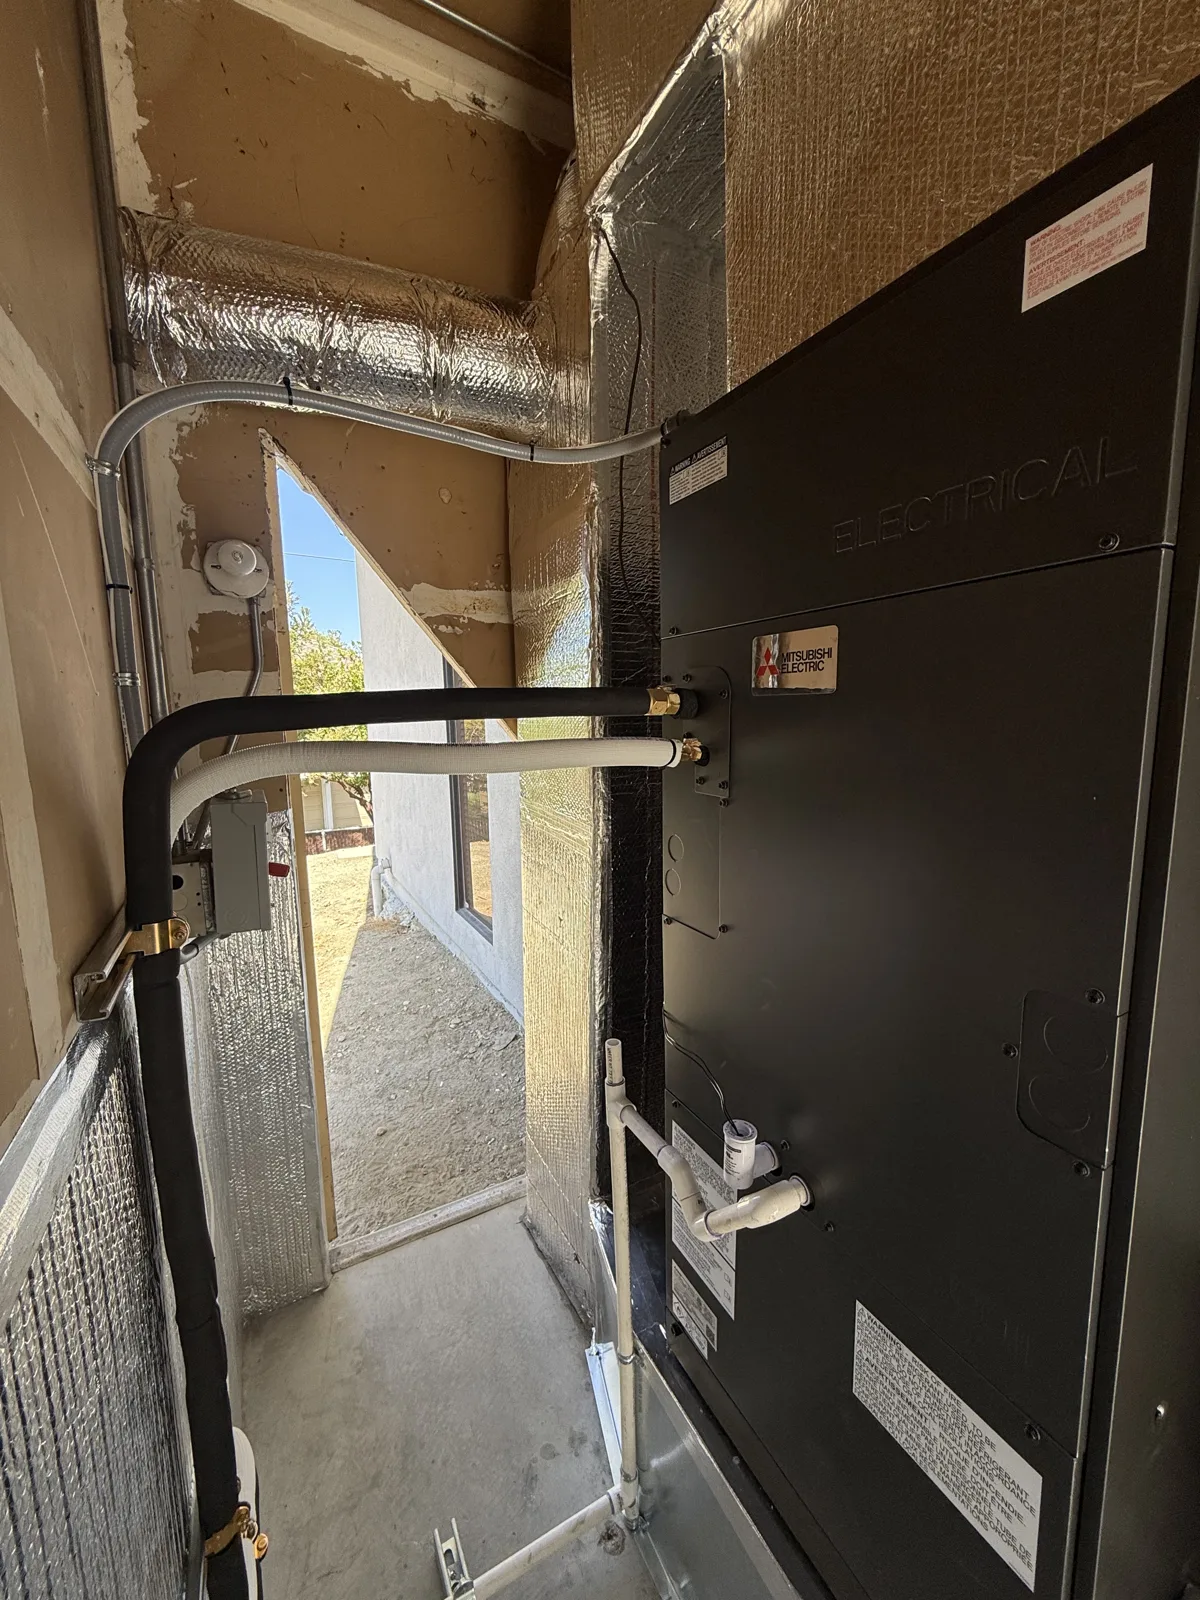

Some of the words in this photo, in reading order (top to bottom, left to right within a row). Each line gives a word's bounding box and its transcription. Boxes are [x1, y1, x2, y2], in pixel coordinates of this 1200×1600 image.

[832, 436, 1138, 554] ELECTRICAL
[781, 647, 833, 663] MITSUBISHI
[781, 661, 824, 673] ELECTRIC
[867, 1312, 901, 1352] WARNING
[911, 1355, 929, 1379] RISK
[930, 1373, 941, 1390] OF
